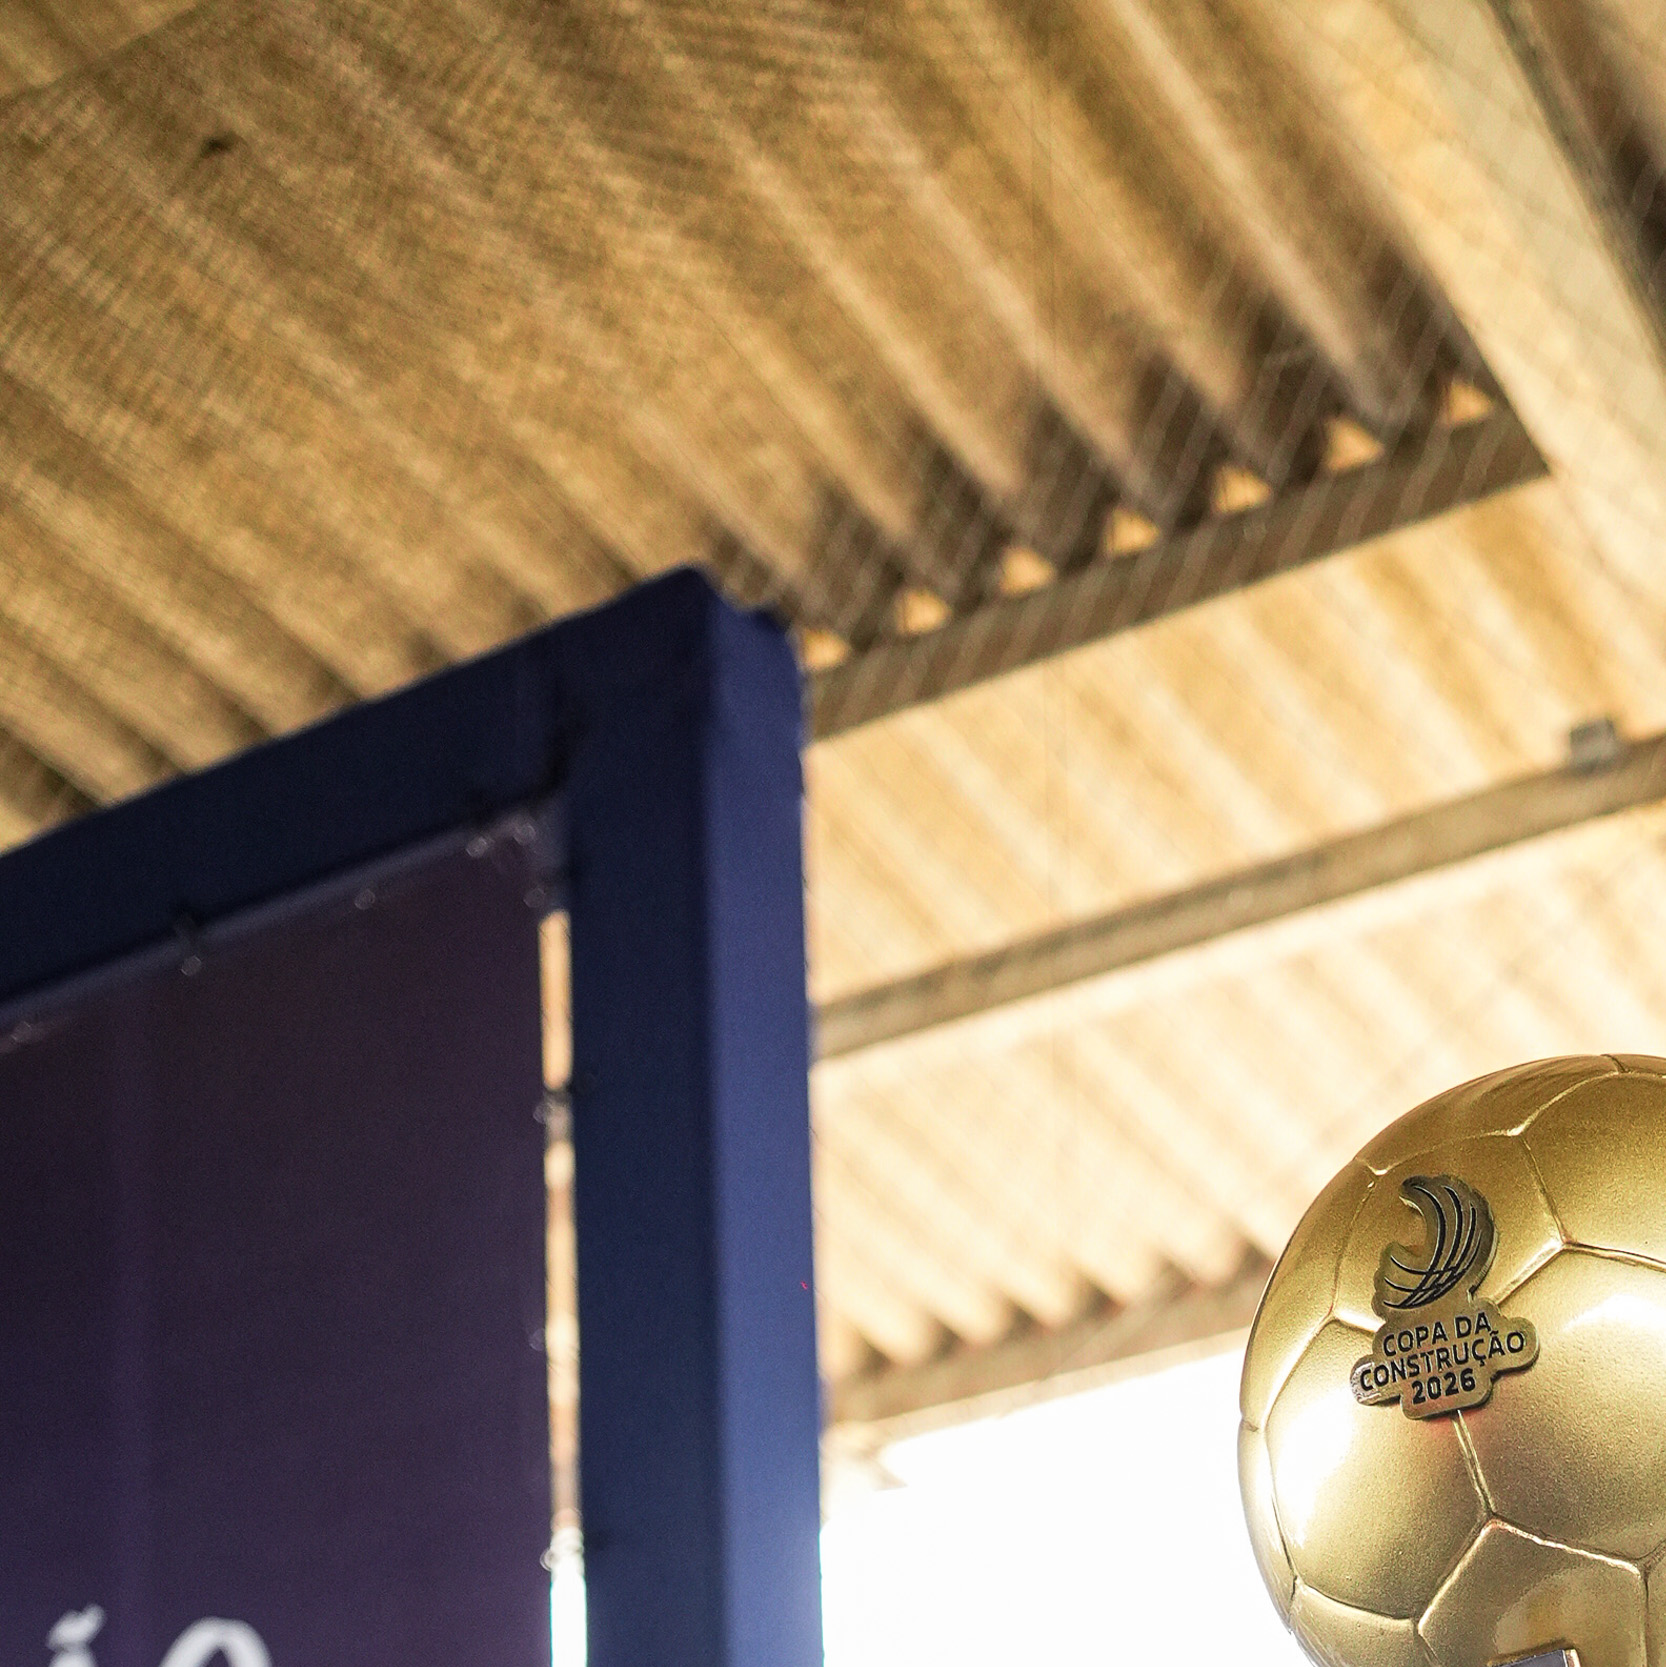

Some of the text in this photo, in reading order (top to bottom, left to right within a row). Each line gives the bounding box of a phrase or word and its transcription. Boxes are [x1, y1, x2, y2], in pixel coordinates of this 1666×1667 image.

[1383, 1312, 1491, 1357] COPA DA
[1360, 1330, 1525, 1391] CONSTRUÇÃO
[1411, 1368, 1476, 1404] 2026
